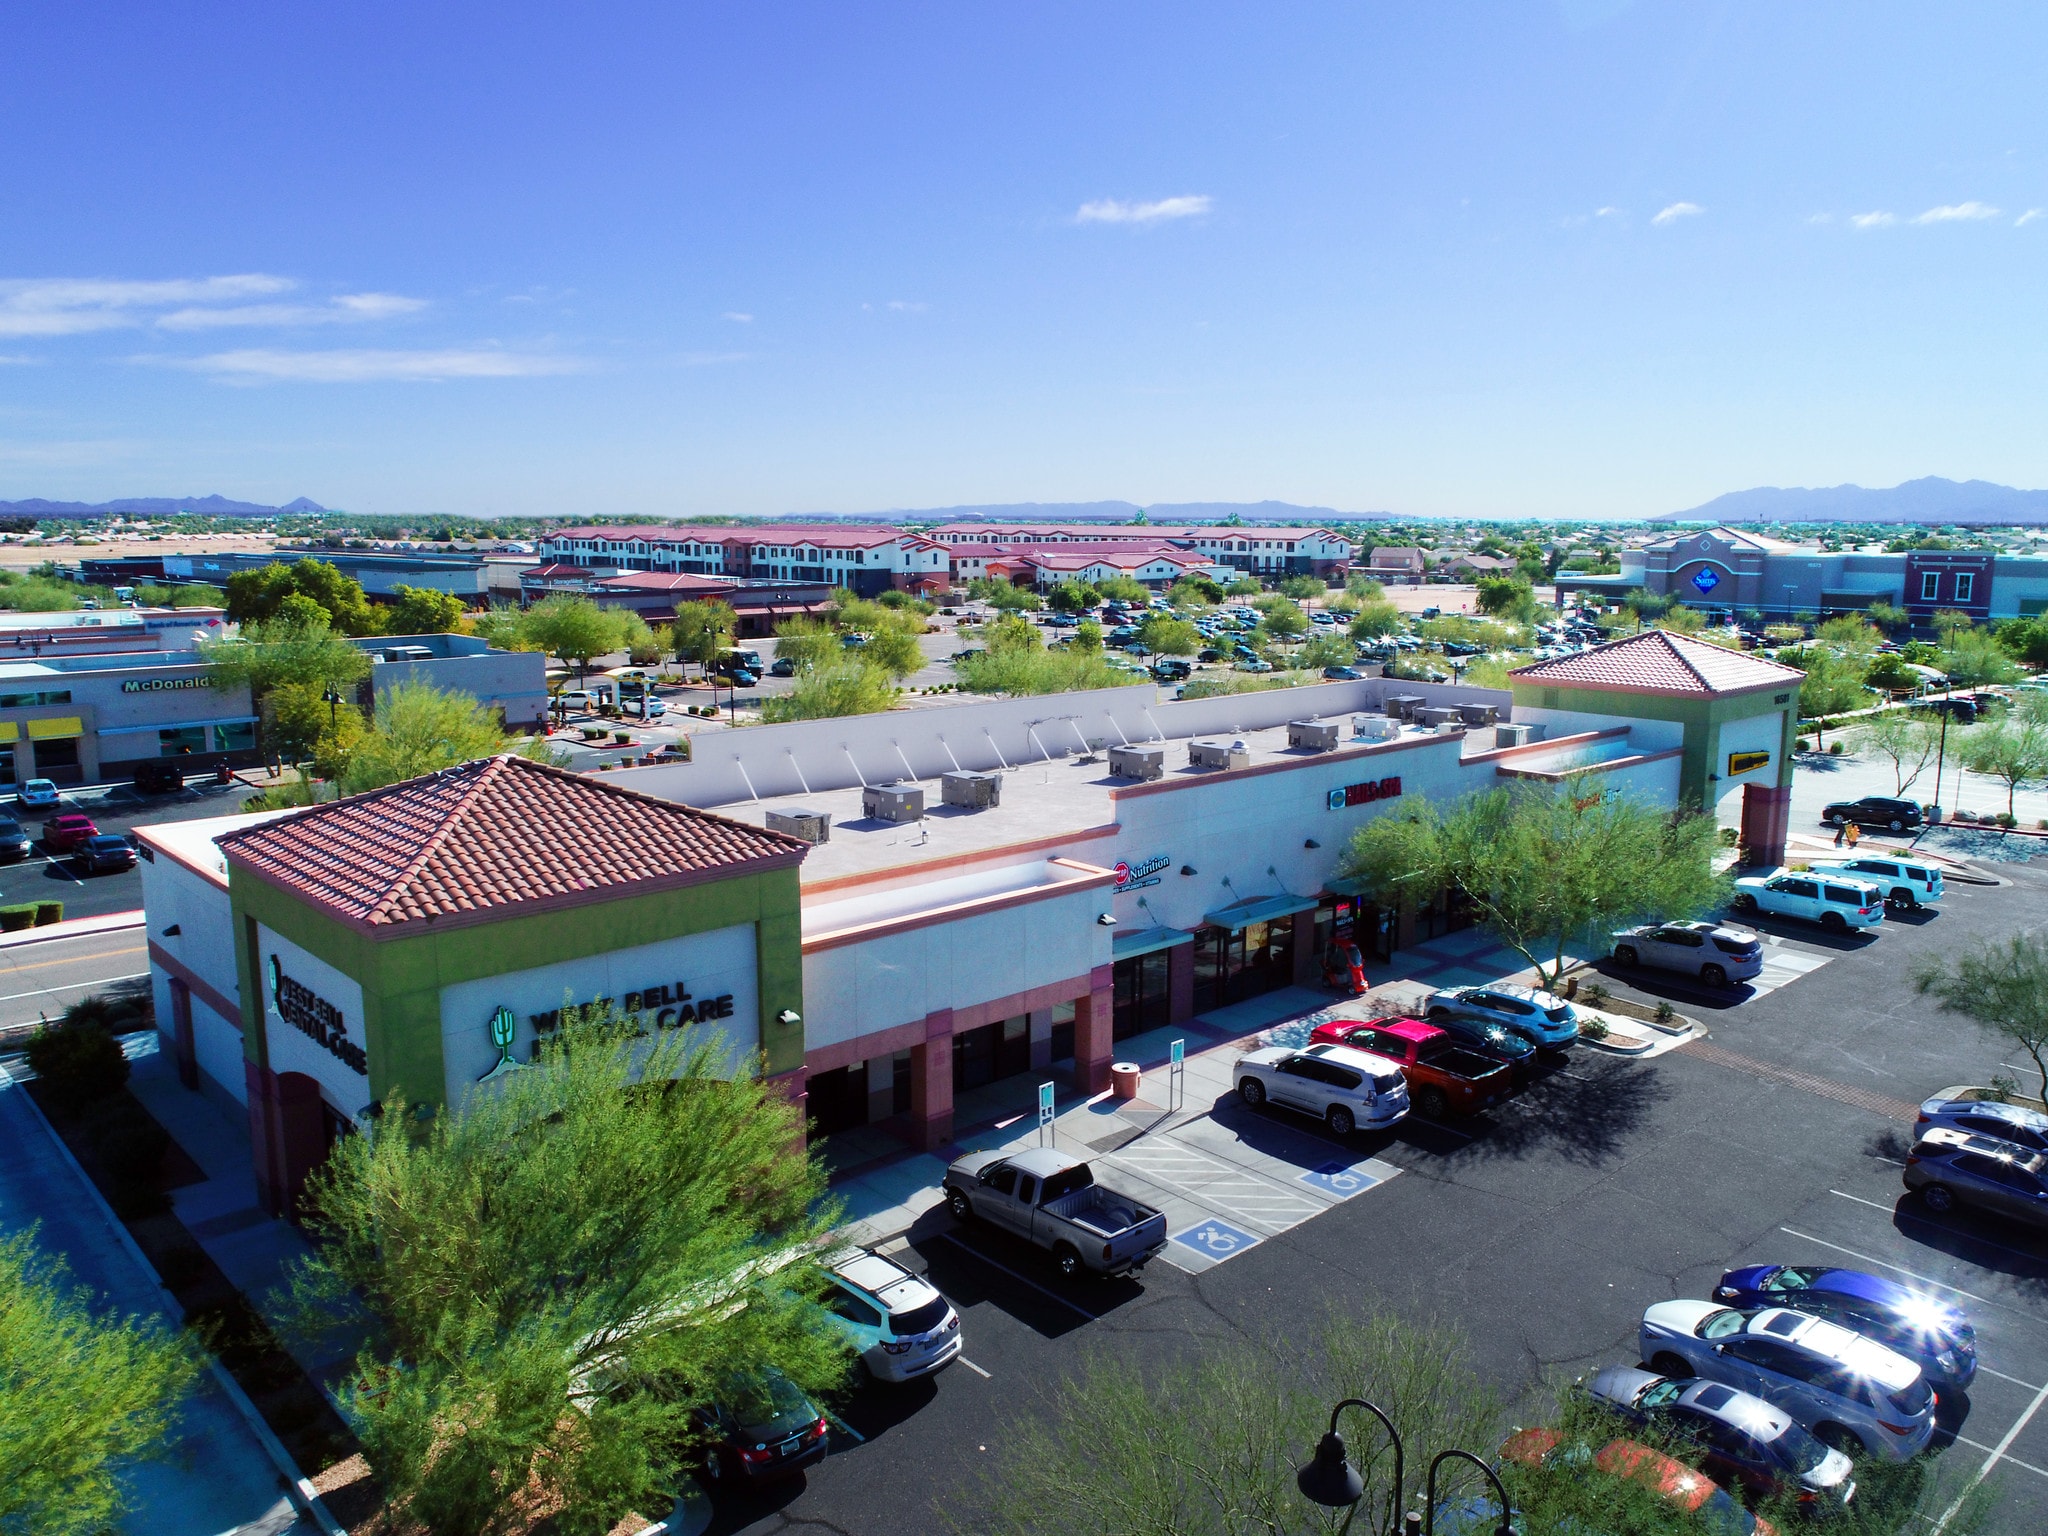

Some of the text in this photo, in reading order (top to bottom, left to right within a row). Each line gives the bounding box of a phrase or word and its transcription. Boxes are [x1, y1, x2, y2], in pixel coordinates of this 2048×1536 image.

[1130, 857, 1170, 882] Nutrition
[314, 997, 347, 1035] BELL
[625, 981, 692, 1014] BELL
[657, 994, 734, 1031] CARE
[328, 1032, 368, 1076] CARE
